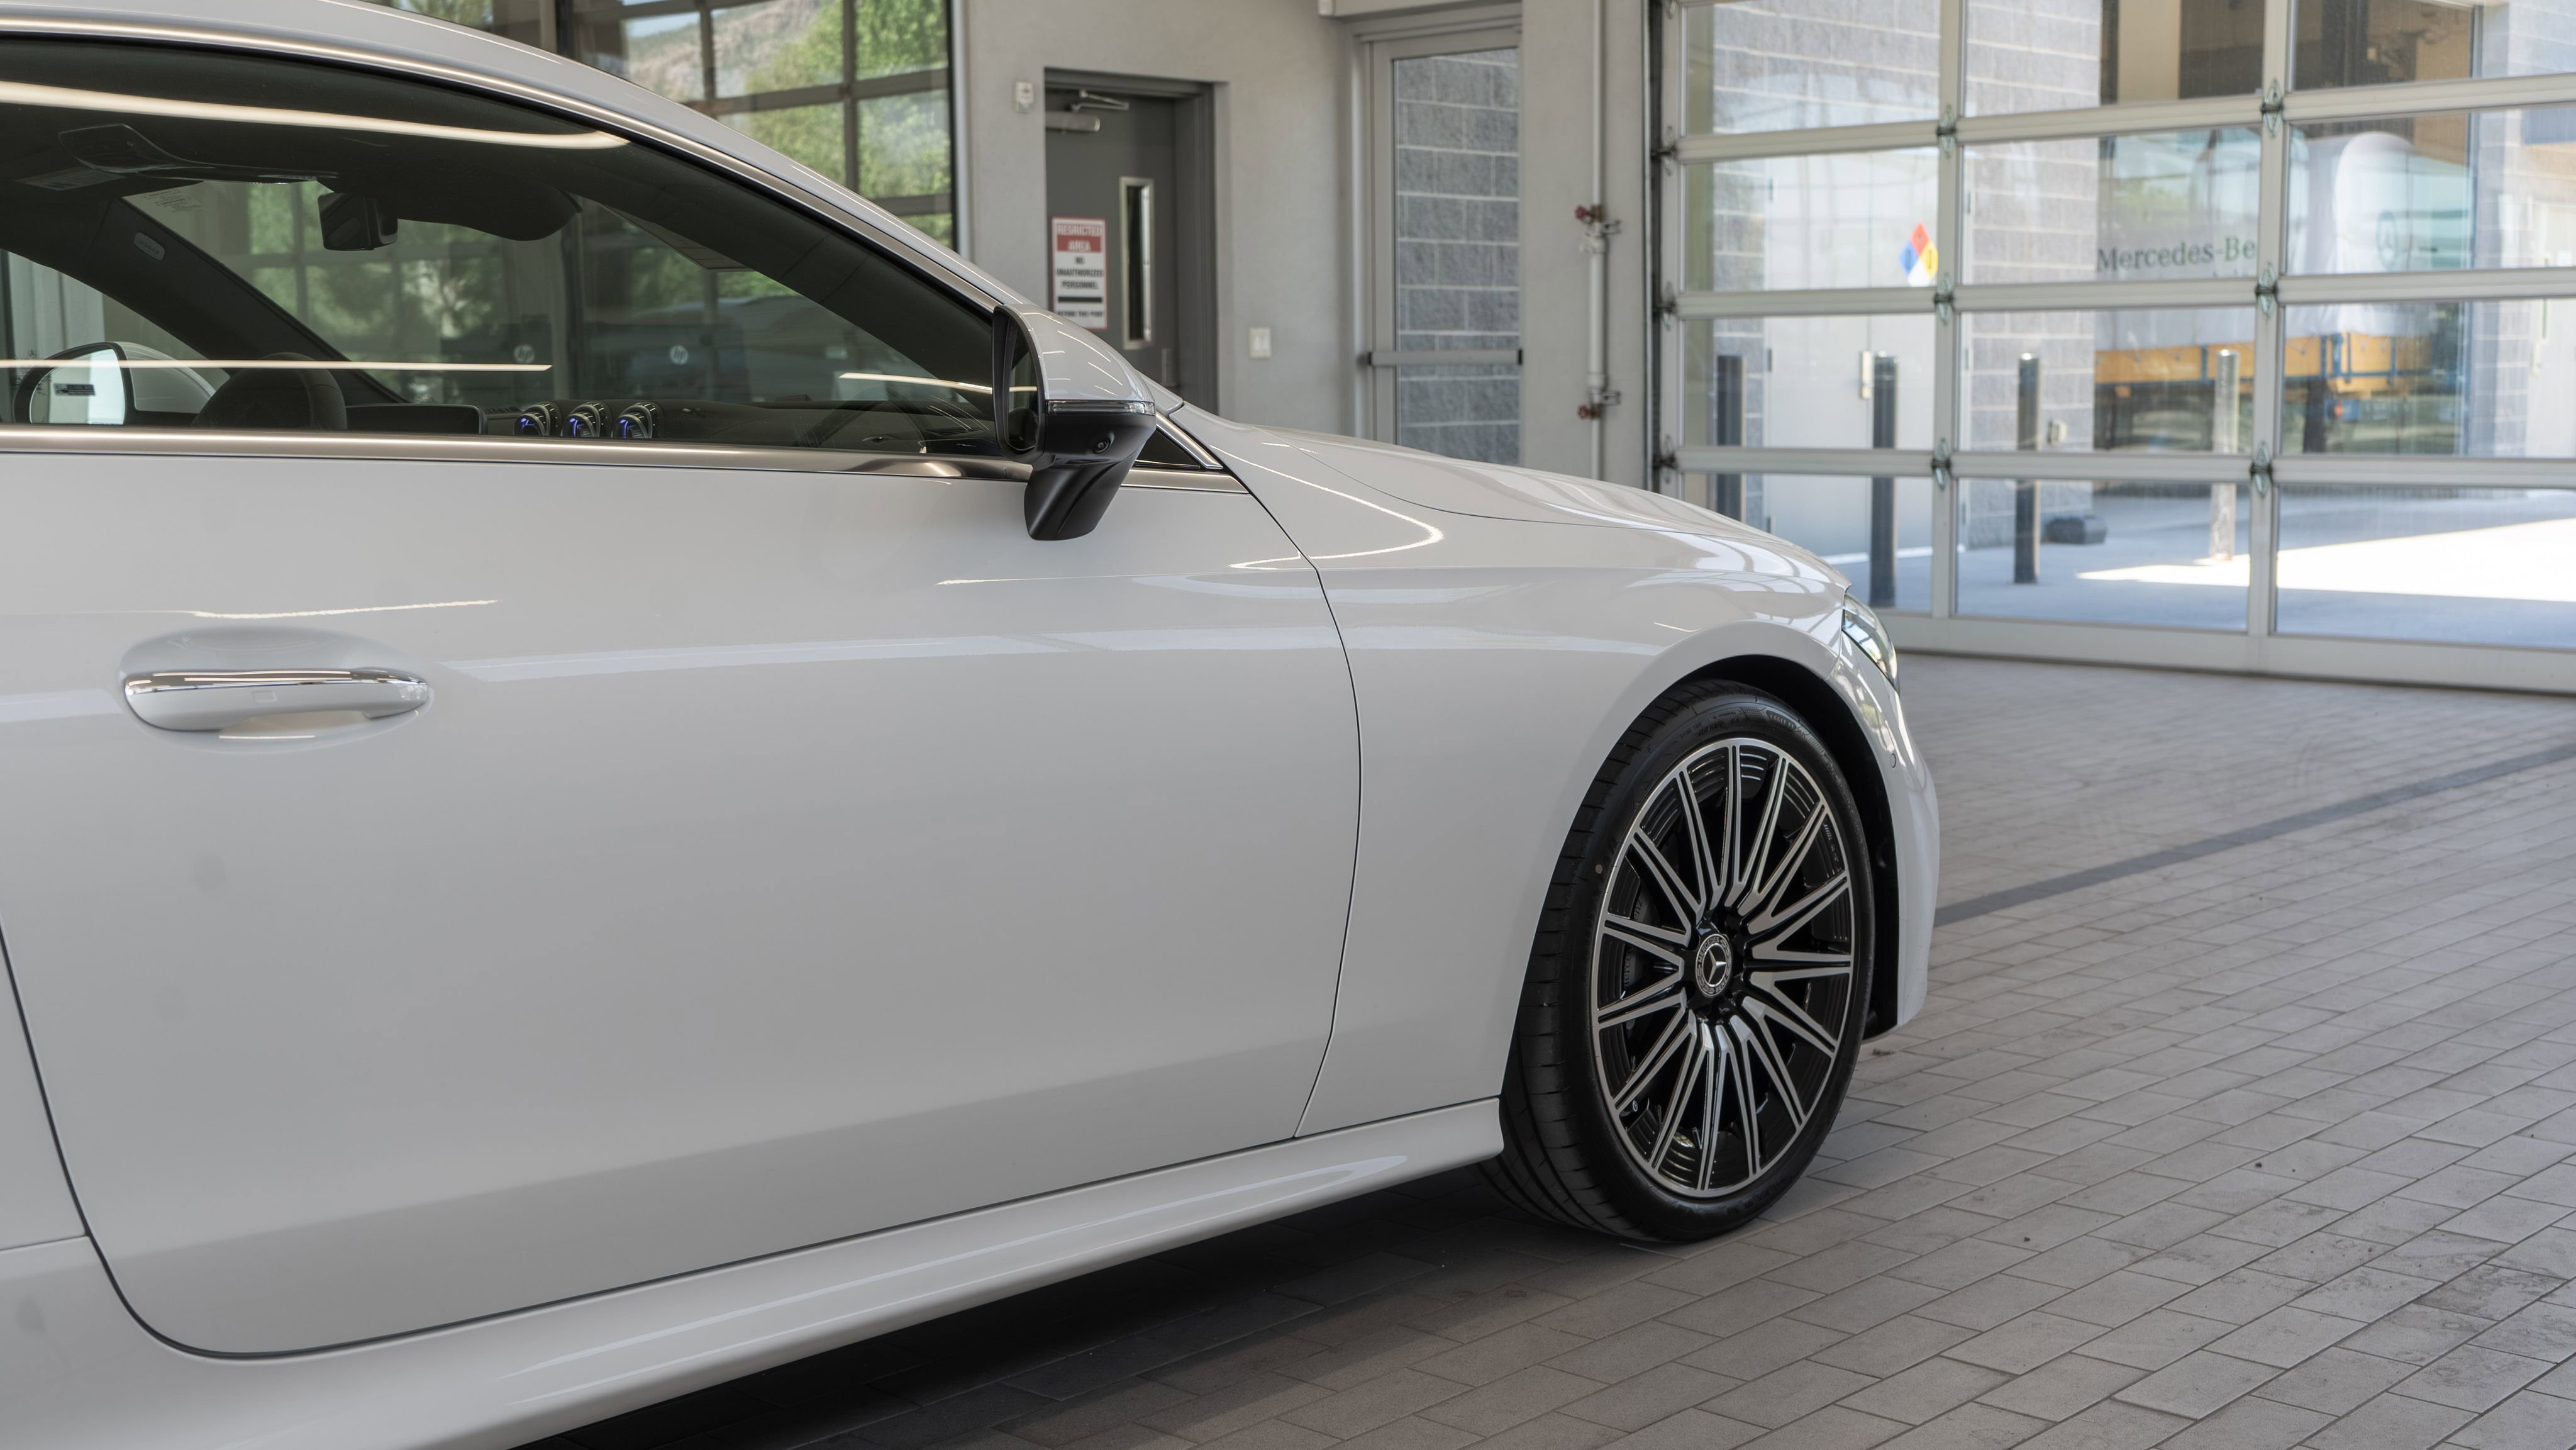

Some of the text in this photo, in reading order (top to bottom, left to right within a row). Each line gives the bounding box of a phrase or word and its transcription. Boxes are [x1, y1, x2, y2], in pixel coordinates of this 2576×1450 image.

[1057, 225, 1102, 236] RESTRICTED
[1067, 240, 1091, 252] AREA
[2097, 236, 2256, 272] Mercedes-Be
[1698, 936, 1720, 963] MERCEDES
[1715, 977, 1728, 993] BENZ
